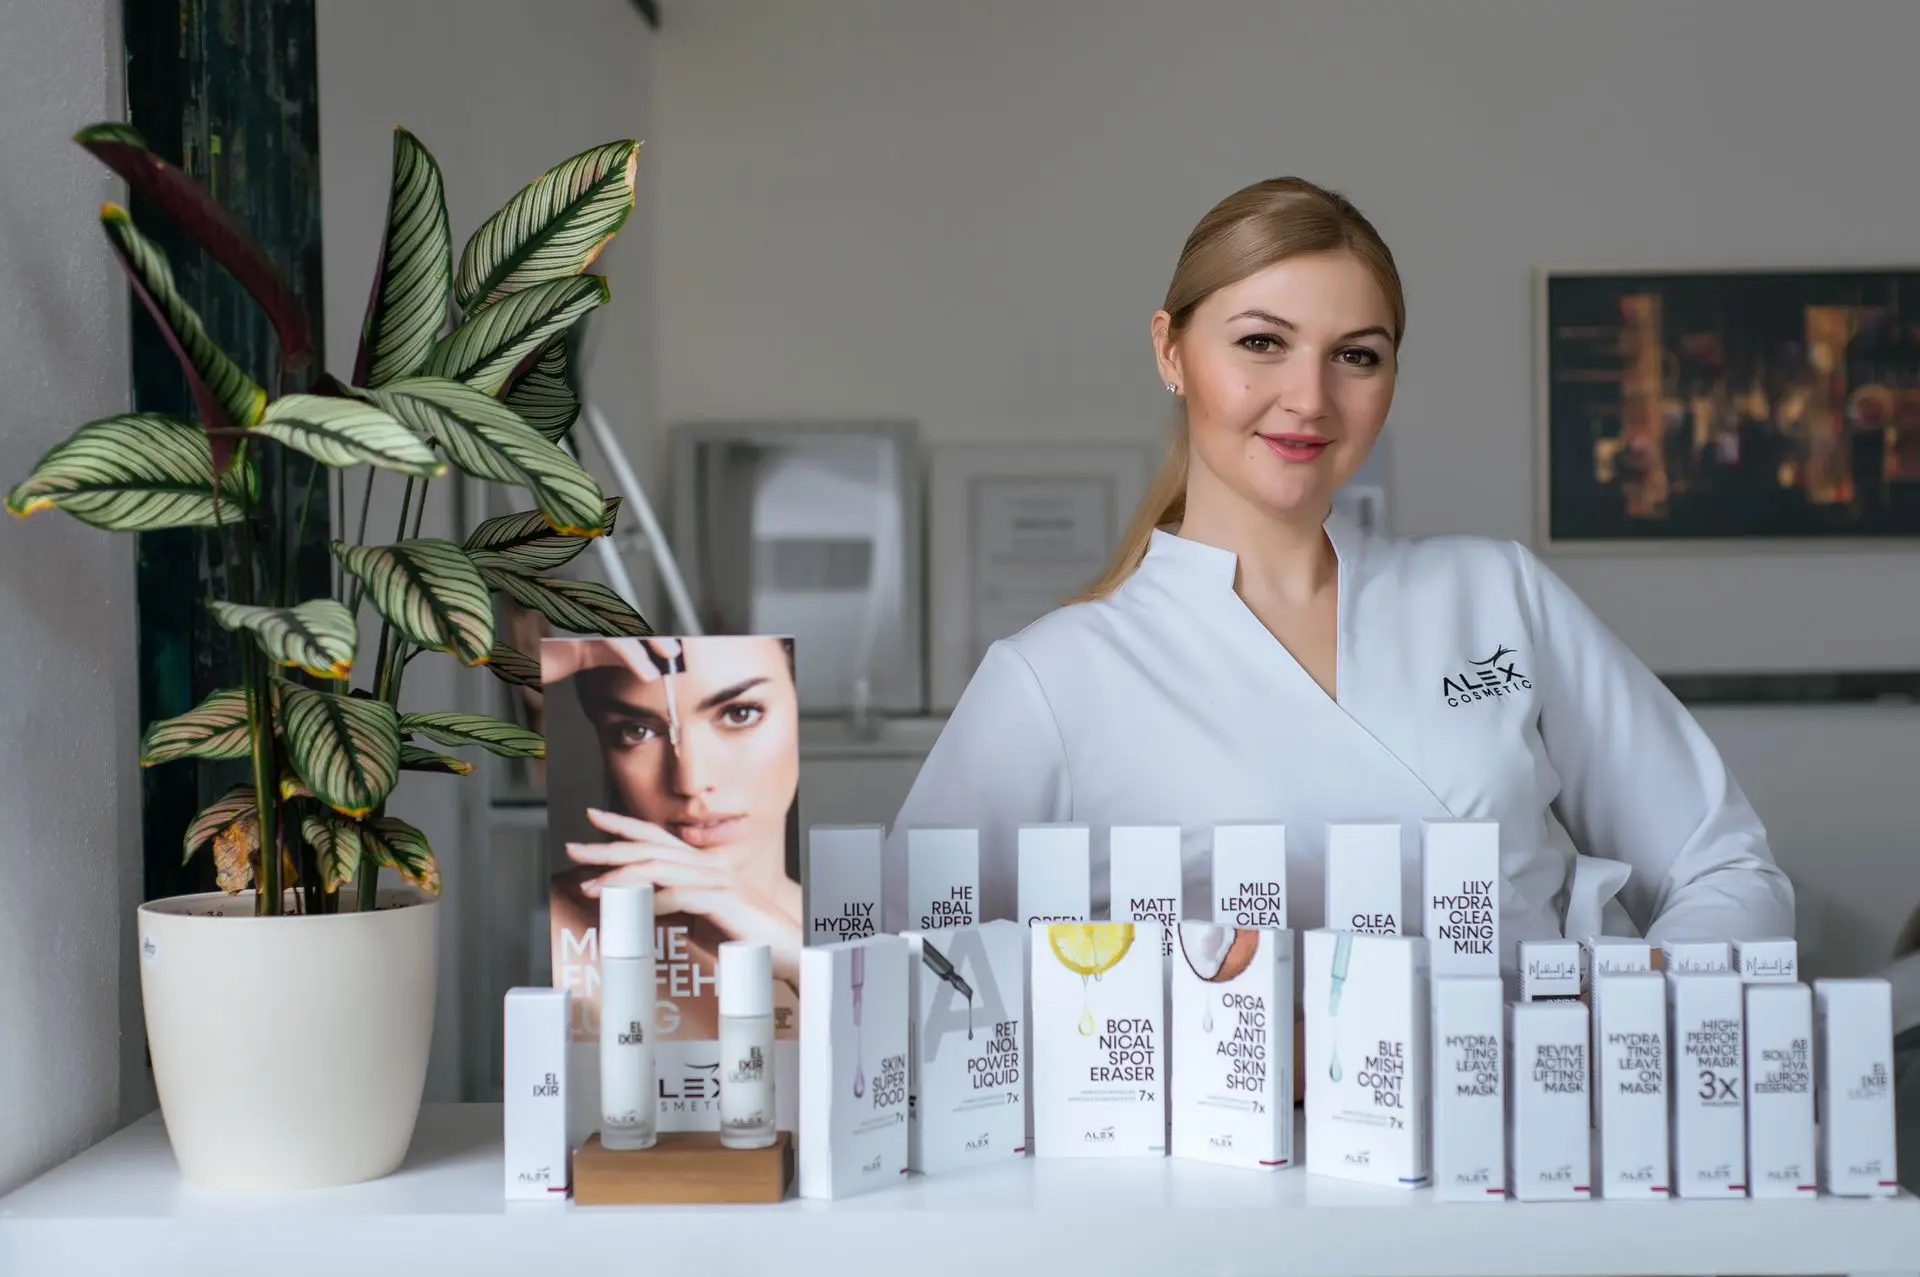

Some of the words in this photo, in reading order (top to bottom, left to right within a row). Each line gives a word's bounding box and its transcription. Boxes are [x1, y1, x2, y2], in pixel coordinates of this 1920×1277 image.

[1443, 662, 1526, 697] ALEX
[1447, 679, 1532, 708] COSMETIC
[951, 886, 973, 900] HE
[1239, 882, 1280, 896] MILD
[1463, 880, 1493, 895] LILY
[931, 901, 973, 915] RBAL
[1130, 898, 1176, 912] MATT
[1221, 897, 1281, 911] LEMON
[1433, 895, 1494, 909] HYDRA
[844, 903, 874, 917] LILY
[1449, 910, 1494, 924] CLEA
[814, 918, 875, 931] HYDRA
[1236, 912, 1281, 926] CLEA
[1352, 914, 1396, 928] CLEA
[1439, 925, 1494, 939] NSING
[1454, 940, 1493, 954] MILK
[1222, 993, 1265, 1011] ORGA
[1107, 1019, 1154, 1034] BOTA
[1239, 1011, 1265, 1028] NIC
[1702, 1020, 1739, 1031] HIGH
[629, 1021, 643, 1033] EL
[995, 1021, 1018, 1038] RET
[617, 1033, 643, 1045] IXIR
[1233, 1026, 1266, 1044] ANTI
[1446, 1035, 1498, 1048] HYDRA
[1608, 1033, 1661, 1046] HYDRA
[1688, 1032, 1739, 1044] PERFOR
[986, 1037, 1018, 1055] INOL
[1099, 1035, 1155, 1050] NICAL
[1378, 1040, 1404, 1058] BLE
[750, 1047, 763, 1059] EL
[1216, 1041, 1266, 1060] AGING
[1463, 1048, 1498, 1060] TING
[1536, 1044, 1584, 1058] REVIVE
[1627, 1046, 1661, 1058] TING
[1686, 1044, 1740, 1056] MANCE
[1762, 1050, 1808, 1061] SOLUTE
[738, 1059, 764, 1072] IXIR
[881, 1053, 905, 1074] SKIN
[967, 1053, 1019, 1074] POWER
[1109, 1051, 1155, 1066] SPOT
[1365, 1055, 1404, 1075] MISH
[1535, 1057, 1584, 1069] ACTIVE
[1619, 1058, 1661, 1070] LEAVE
[1698, 1056, 1739, 1068] MASK
[1233, 1058, 1266, 1077] SKIN
[1456, 1060, 1498, 1072] LEAVE
[1781, 1061, 1808, 1071] HYA
[544, 1072, 558, 1085] EL
[973, 1068, 1019, 1090] LIQUID
[1090, 1066, 1155, 1081] ERASER
[1357, 1071, 1404, 1090] CONT
[1476, 1073, 1499, 1085] ON
[1533, 1069, 1584, 1081] LIFTING
[1639, 1071, 1662, 1083] ON
[872, 1070, 905, 1093] SUPER
[1226, 1074, 1265, 1093] SHOT
[1544, 1082, 1584, 1094] MASK
[1619, 1082, 1662, 1095] MASK
[1754, 1082, 1808, 1094] ESSENCE
[532, 1085, 560, 1097] IXIR
[1457, 1085, 1499, 1097] MASK
[873, 1087, 905, 1110] FOOD
[1374, 1089, 1404, 1109] ROL
